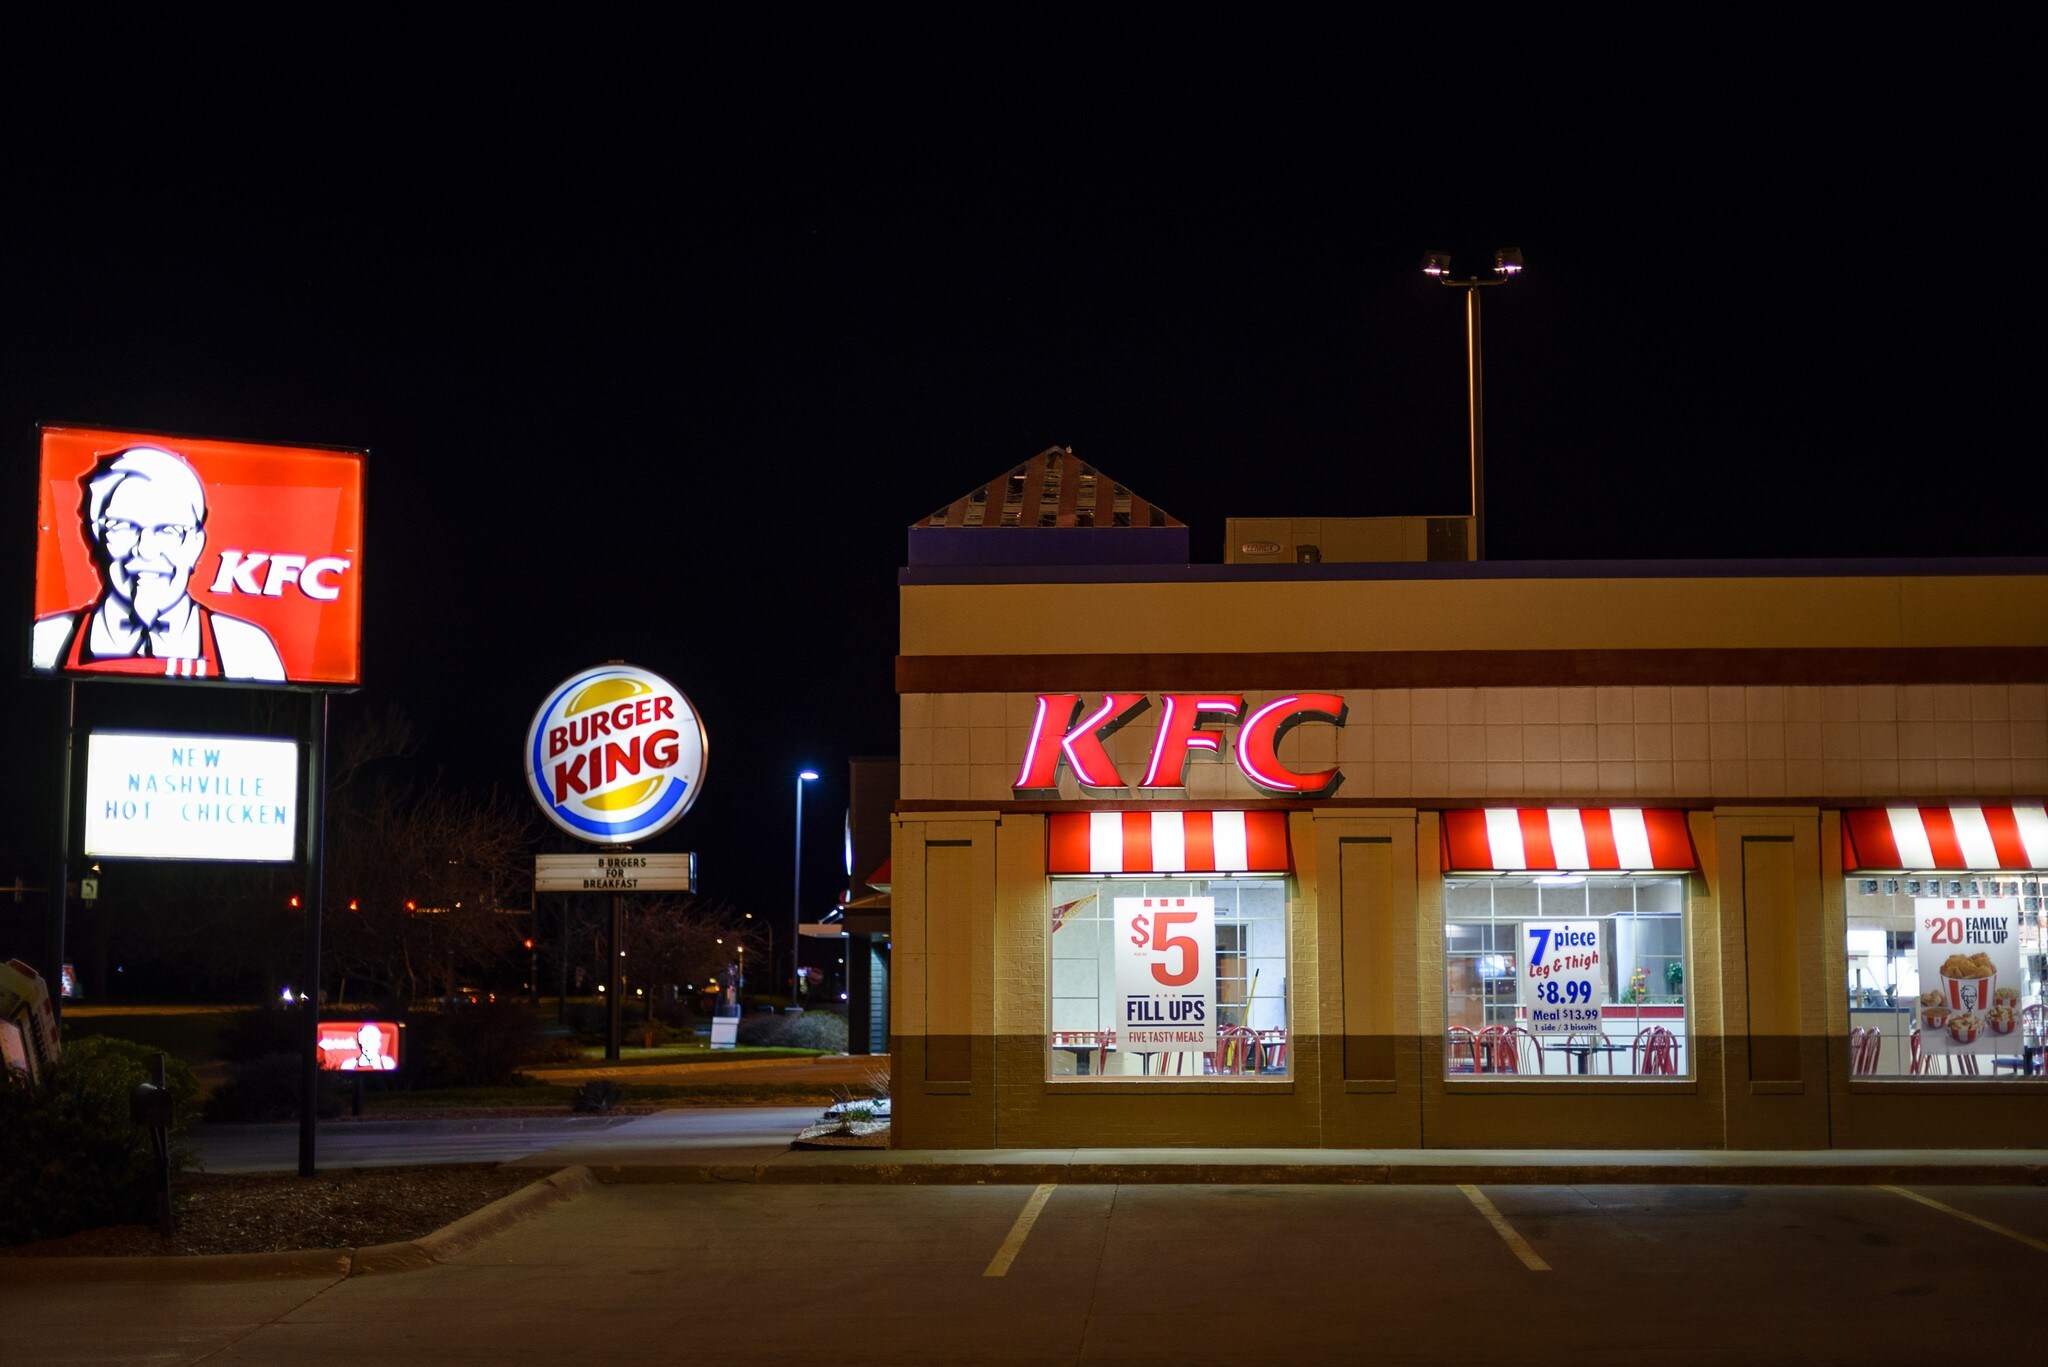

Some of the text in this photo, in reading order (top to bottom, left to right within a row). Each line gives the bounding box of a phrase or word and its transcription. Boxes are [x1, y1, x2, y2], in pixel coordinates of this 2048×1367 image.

[209, 550, 351, 601] KFC
[549, 696, 674, 758] BURGER
[1011, 693, 1347, 796] KFC
[171, 746, 221, 768] NEW
[554, 728, 679, 805] KING
[128, 774, 265, 797] NASHVILLE
[105, 800, 287, 825] HOT CHICKEN
[583, 879, 638, 889] BREAKFAST
[606, 868, 624, 878] FOR
[1925, 917, 2008, 944] $20 FAMILY
[1966, 930, 2008, 944] FILL UP
[1131, 911, 1199, 987] $5
[1529, 925, 1596, 966] 7 piece
[1529, 951, 1599, 979] Leg & Thigh
[1537, 980, 1592, 1004] $8.99
[1127, 1000, 1205, 1021] FILL UPS
[1533, 1009, 1598, 1020] Meal $13.99
[1129, 1031, 1204, 1043] FIVE TASTY MEALS
[1541, 1023, 1556, 1031] side
[1571, 1023, 1597, 1031] biscuits
